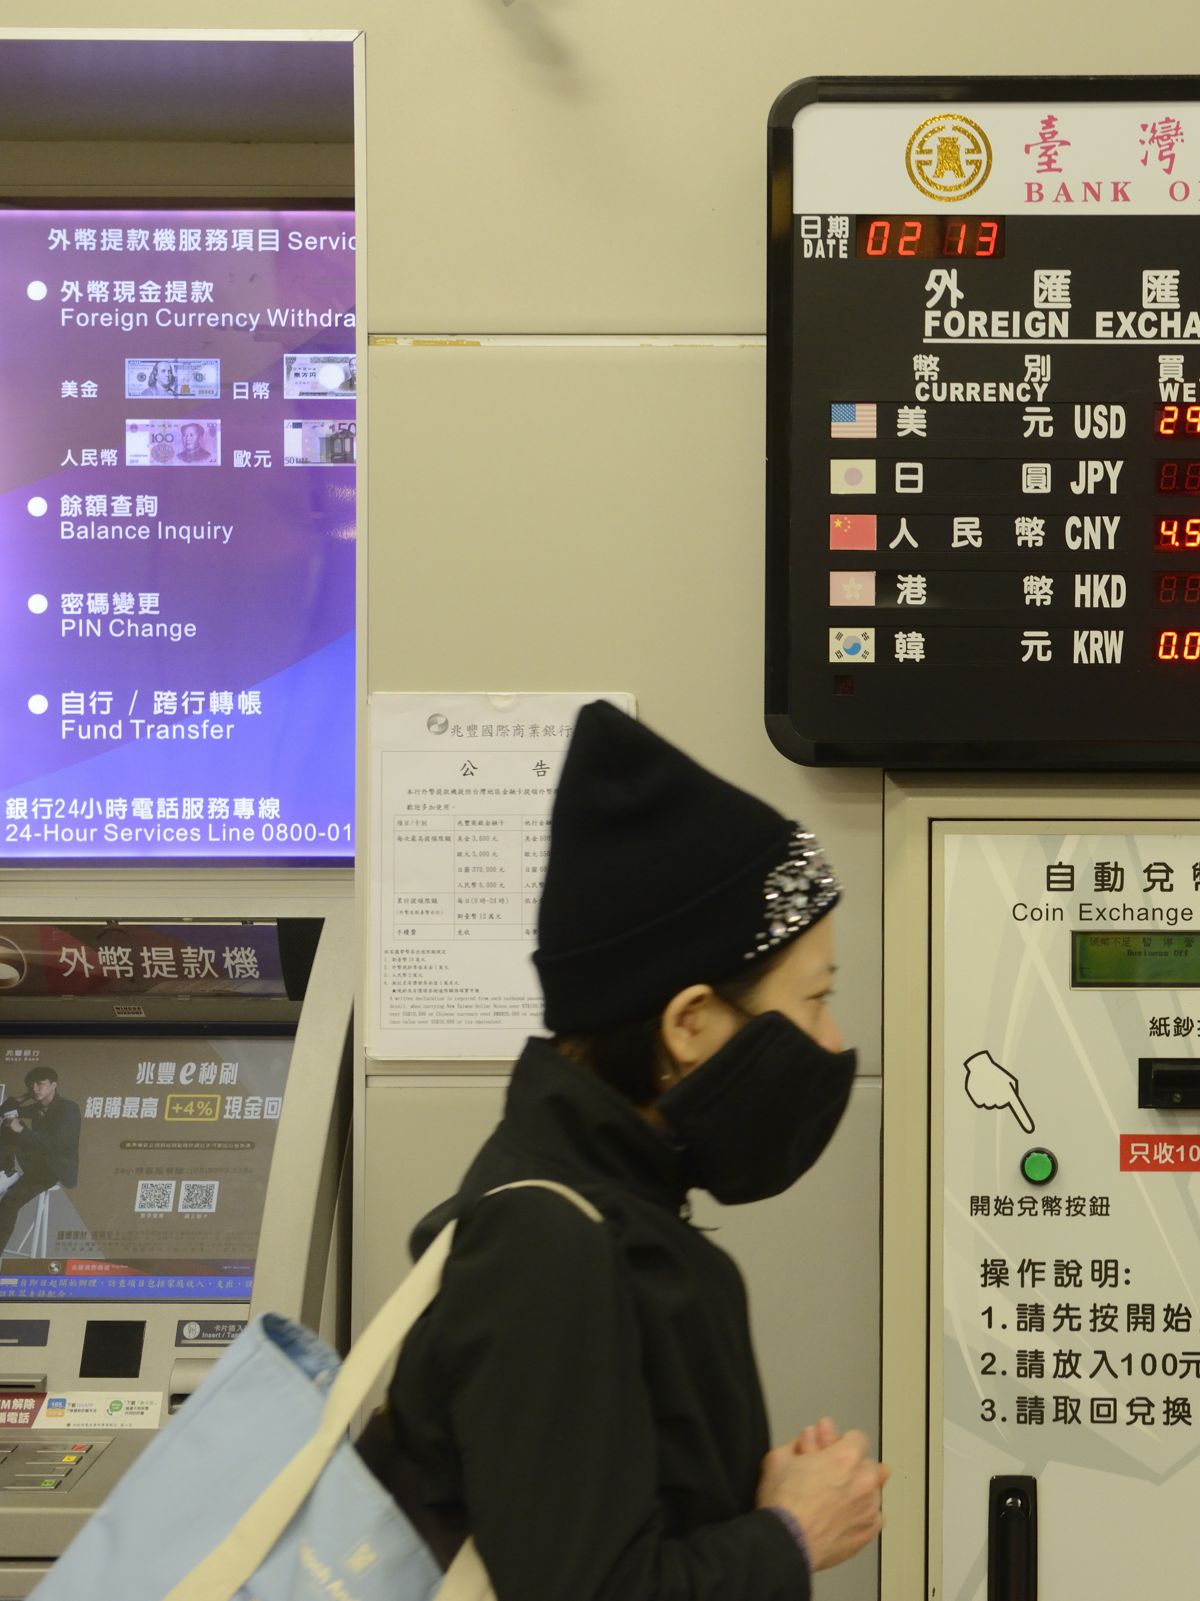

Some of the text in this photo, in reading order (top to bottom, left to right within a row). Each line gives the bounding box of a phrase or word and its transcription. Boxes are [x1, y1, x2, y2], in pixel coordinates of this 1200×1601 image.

[1024, 181, 1132, 203] BANK
[801, 216, 849, 239] 日期
[48, 228, 279, 251] 外幣提款機服務項目
[803, 239, 848, 259] DATE
[866, 221, 998, 257] 02 13
[61, 280, 214, 303] 外幣現金提款
[61, 308, 148, 330] Foreign
[156, 309, 260, 331] Currency
[923, 311, 1069, 338] FOREIGN
[913, 354, 1051, 382] 幣別
[61, 381, 98, 398] 美金
[233, 382, 270, 399] 日幣
[915, 382, 1048, 402] CURRENCY
[1159, 383, 1197, 402] WE
[897, 405, 1126, 439] 美元 USD
[61, 449, 118, 467] 人民幣
[233, 450, 272, 468] 歐元
[895, 461, 1124, 494] 日圓 JPY
[60, 495, 158, 517] 餘額查詢
[60, 522, 234, 543] Balance Inquiry
[889, 515, 1121, 550] 人民幣 CNY
[897, 574, 1127, 608] 港幣 HKD
[61, 593, 160, 615] 密碼變更
[61, 619, 197, 641] PIN Change
[894, 630, 1124, 664] 韓元 KRW
[61, 691, 113, 715] 自行
[153, 691, 262, 715] 跨行轉帳
[61, 720, 235, 740] Fund Transfer
[451, 724, 571, 738] 兆豐國際商業銀行
[460, 760, 550, 777] 公告
[5, 798, 280, 820] 銀行24小時電話服務專線
[5, 824, 351, 842] 24-Hour Services Line 0800-01
[1012, 903, 1064, 922] Coin
[1078, 903, 1194, 926] Exchange
[59, 946, 260, 979] 外幣提款機
[136, 1061, 239, 1086] 兆豐e秒刷
[84, 1096, 282, 1120] 網購最高 +4% 現金回
[970, 1196, 1110, 1218] 開始兌幣按鈕
